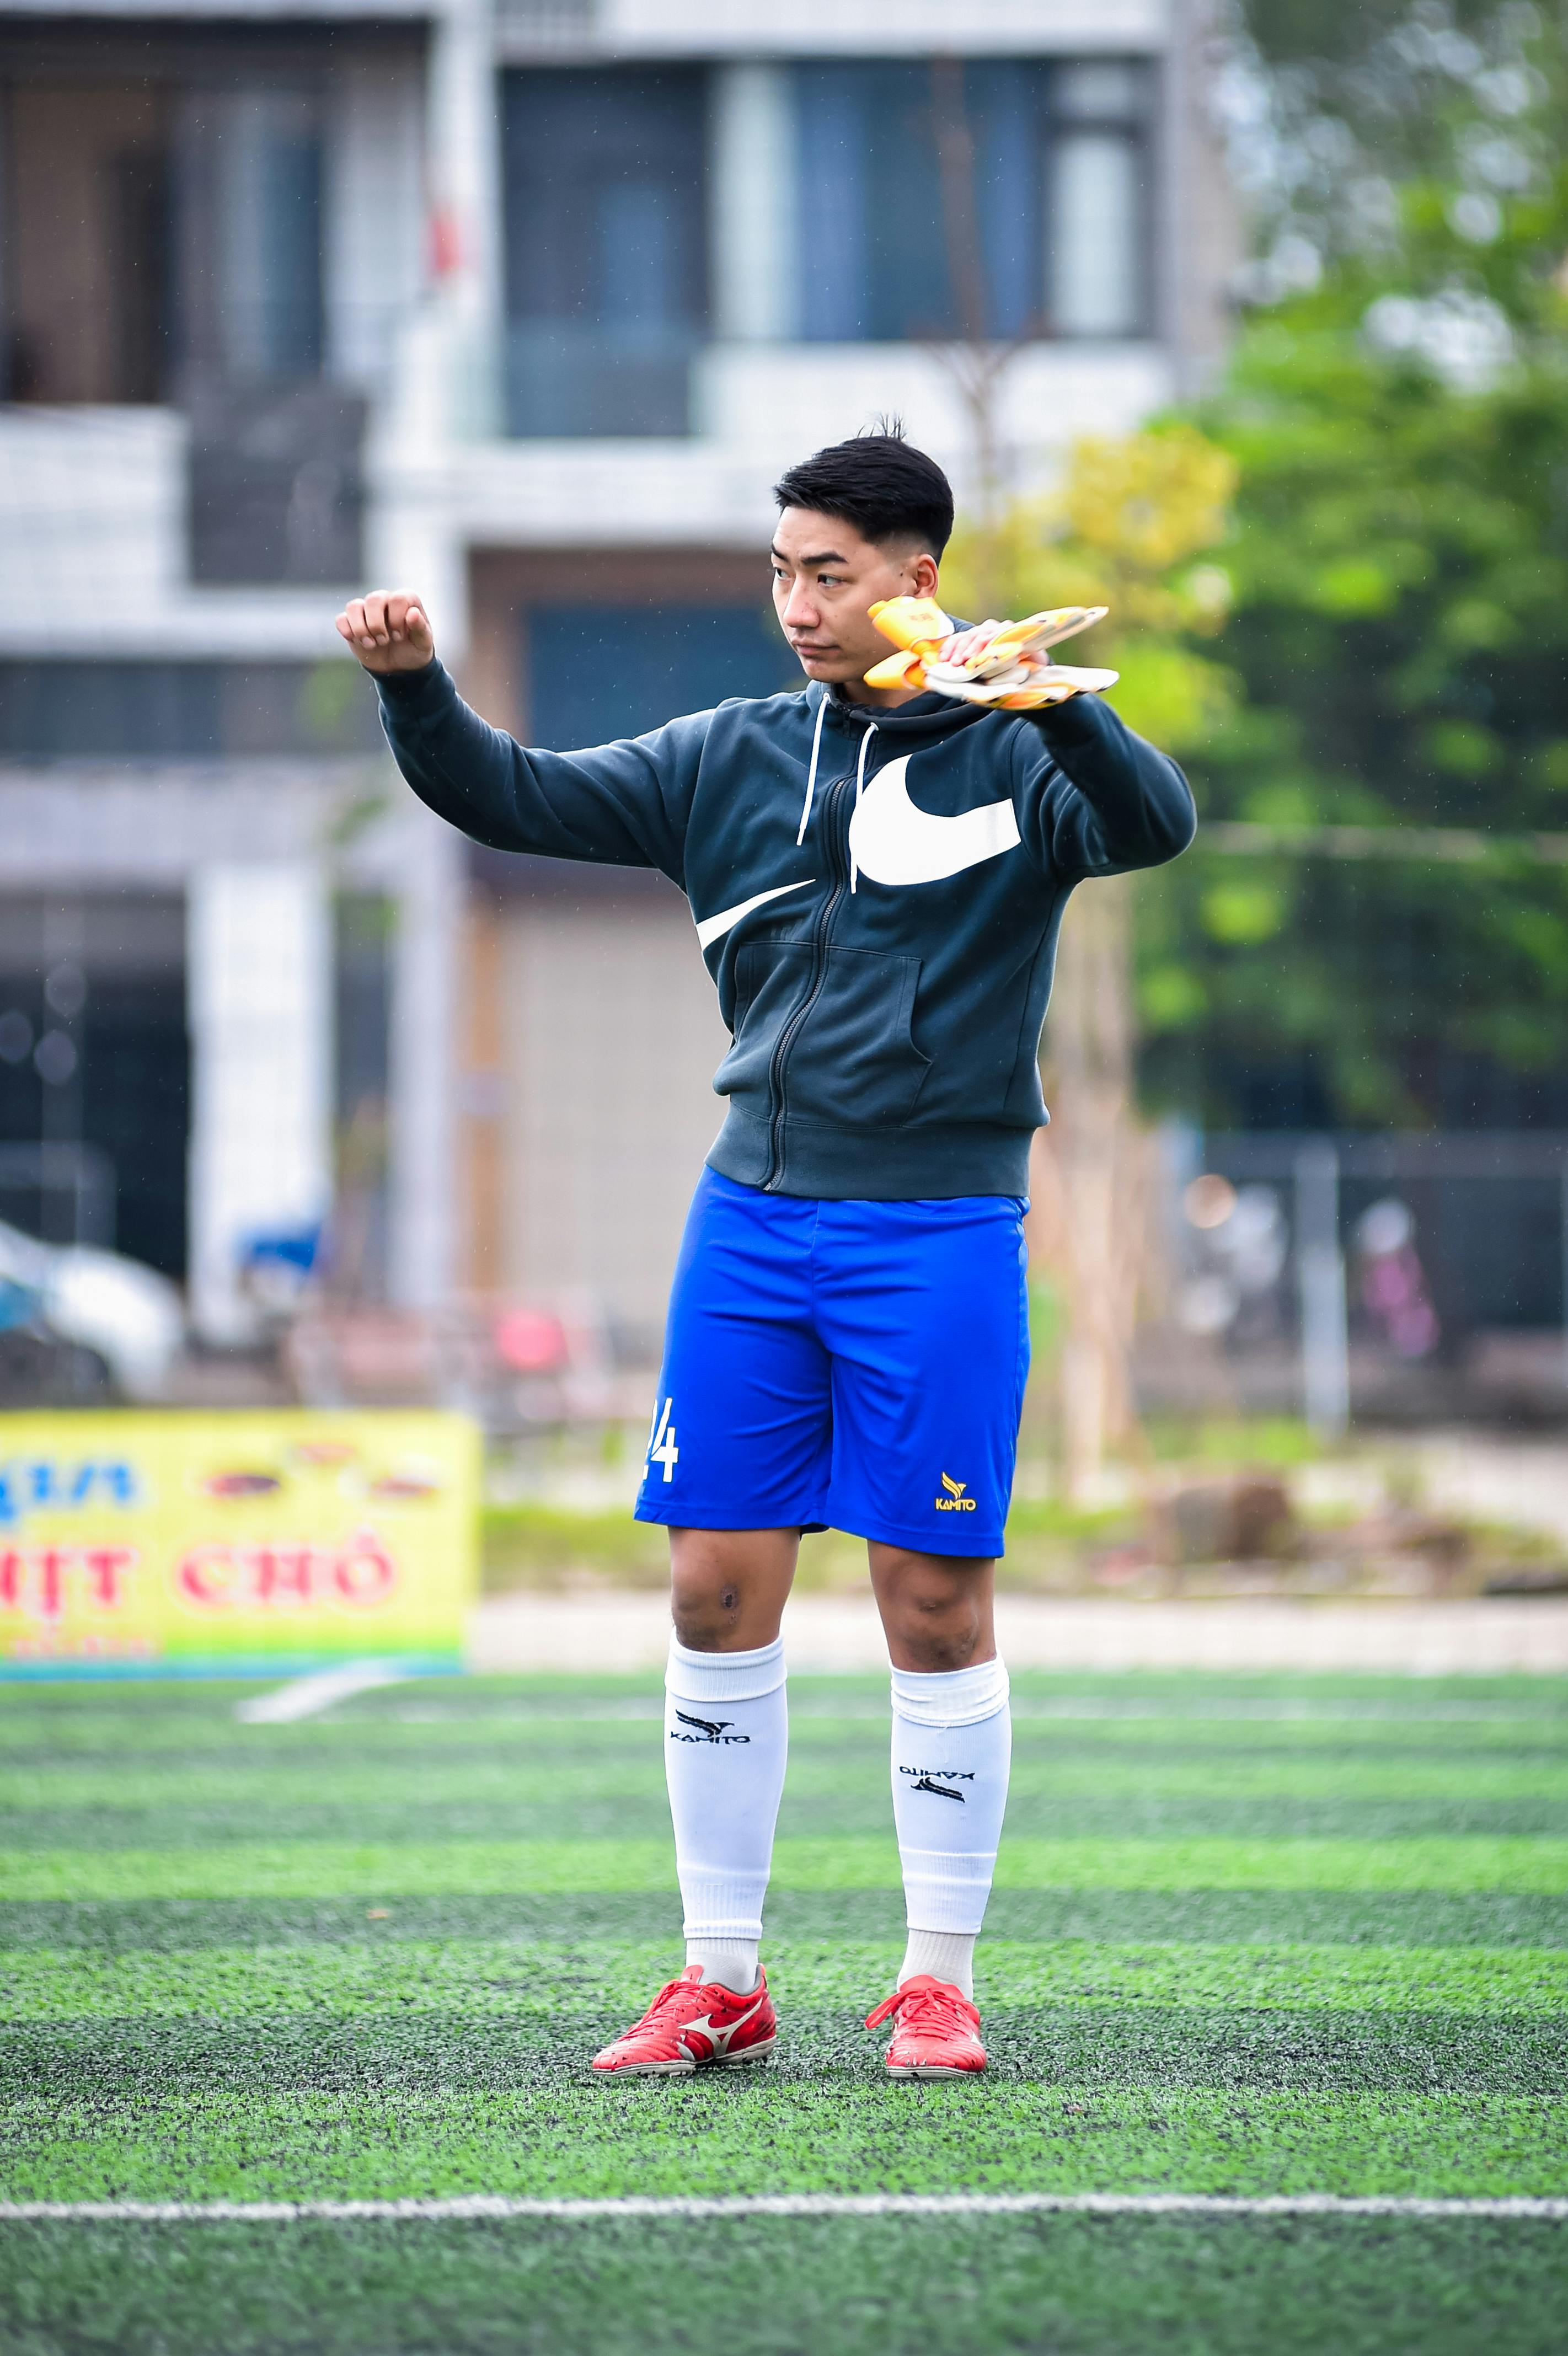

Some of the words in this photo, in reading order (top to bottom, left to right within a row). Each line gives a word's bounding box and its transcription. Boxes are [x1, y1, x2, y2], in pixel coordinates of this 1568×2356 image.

[935, 1498, 976, 1511] KAMITO
[670, 1731, 751, 1744] KAMITO
[899, 1766, 975, 1780] KAMITO
